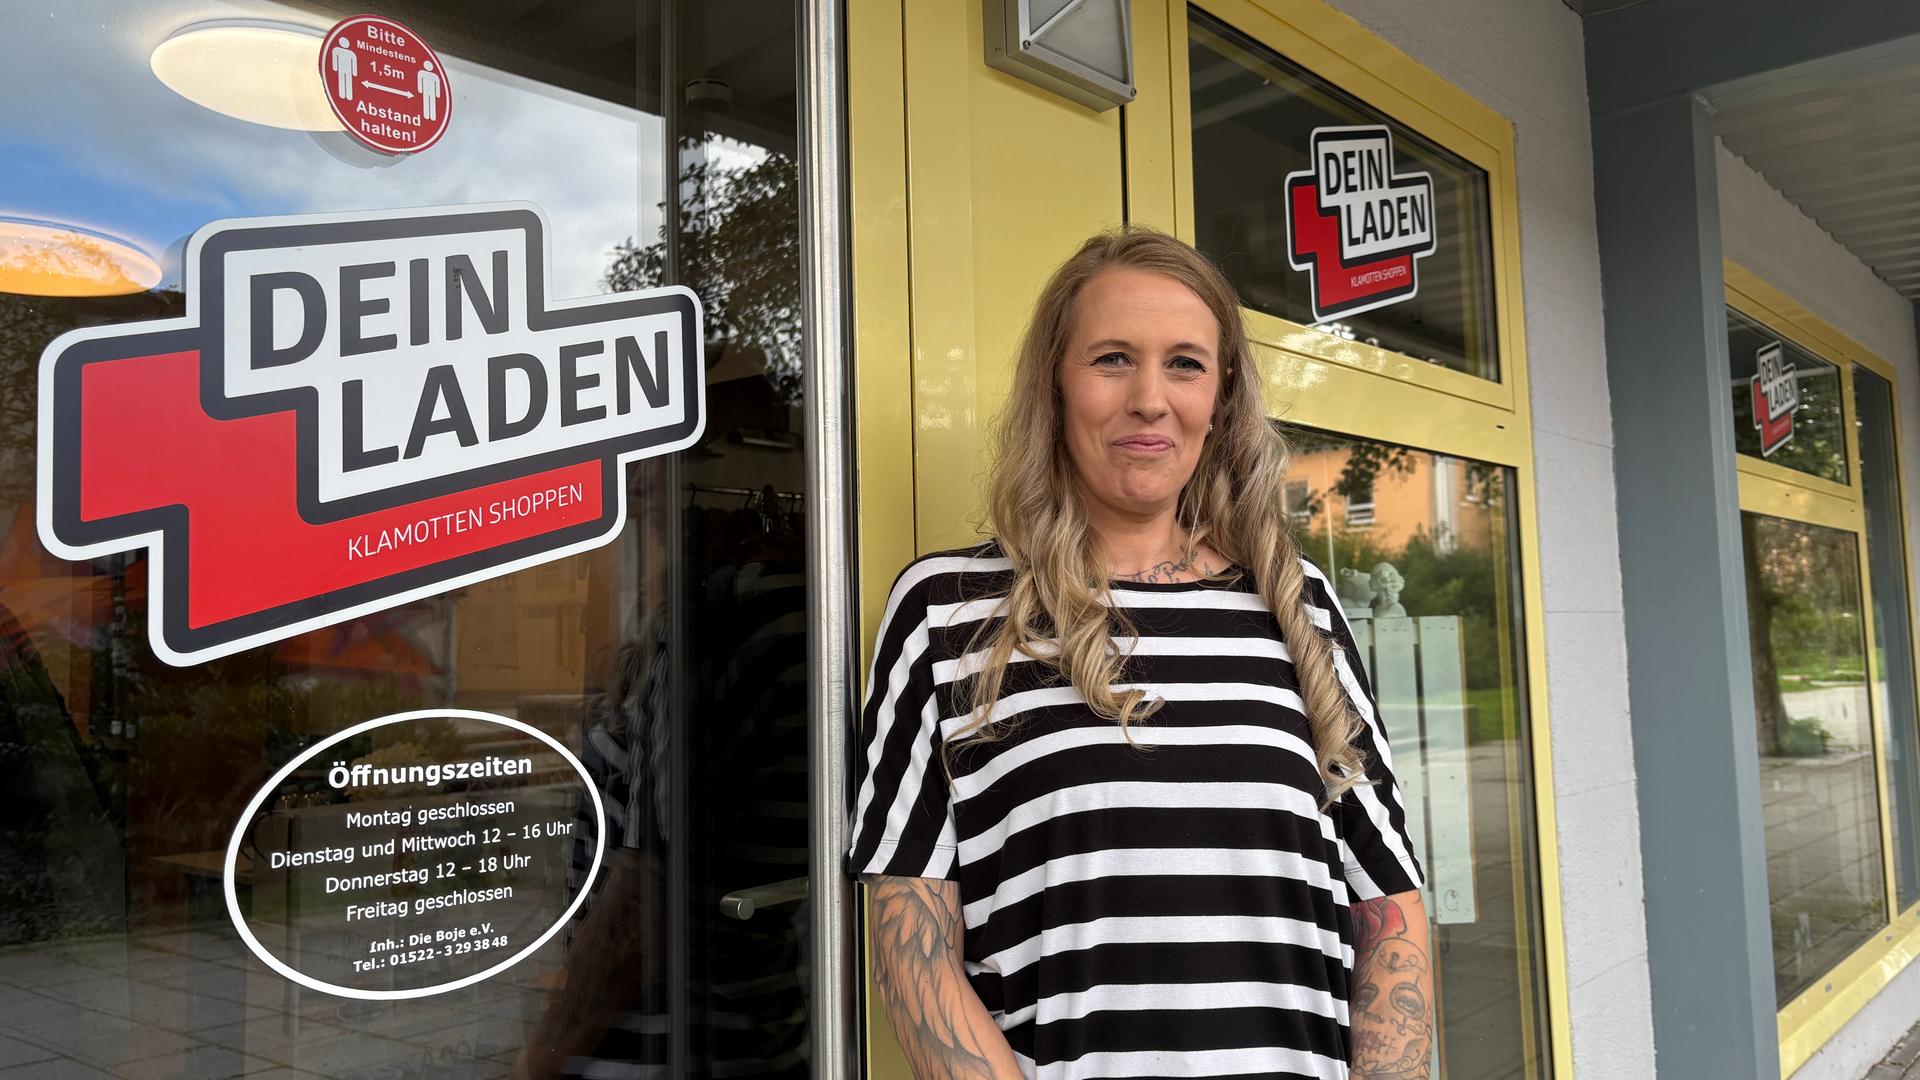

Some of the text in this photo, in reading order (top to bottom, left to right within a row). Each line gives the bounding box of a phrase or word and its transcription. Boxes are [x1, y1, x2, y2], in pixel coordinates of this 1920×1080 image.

[356, 40, 417, 64] Mindestens
[367, 25, 405, 47] Bitte
[370, 61, 405, 80] 1,5m
[356, 100, 421, 127] Abstand
[361, 118, 417, 143] halten!
[1324, 148, 1384, 196] DEIN
[1345, 193, 1427, 248] LADEN
[249, 249, 510, 370] DEIN
[341, 330, 671, 474] LADEN
[348, 482, 583, 561] KLAMOTTEN SHOPPEN
[328, 756, 532, 789] Öffnungszeiten
[346, 801, 515, 829] Montag geschlossen
[271, 846, 355, 869] Dienstag
[362, 838, 395, 858] und
[401, 831, 476, 854] Mittwoch
[482, 828, 501, 844] 12
[522, 823, 541, 839] 16
[546, 820, 573, 836] Uhr
[325, 867, 429, 893] Donnerstag
[436, 862, 456, 879] 12
[478, 856, 498, 873] 18
[503, 854, 531, 870] Uhr
[346, 886, 513, 921] Freitag geschlossen
[369, 922, 495, 953] Inh.: Die Boje e.V.
[353, 958, 385, 973] Tel.:
